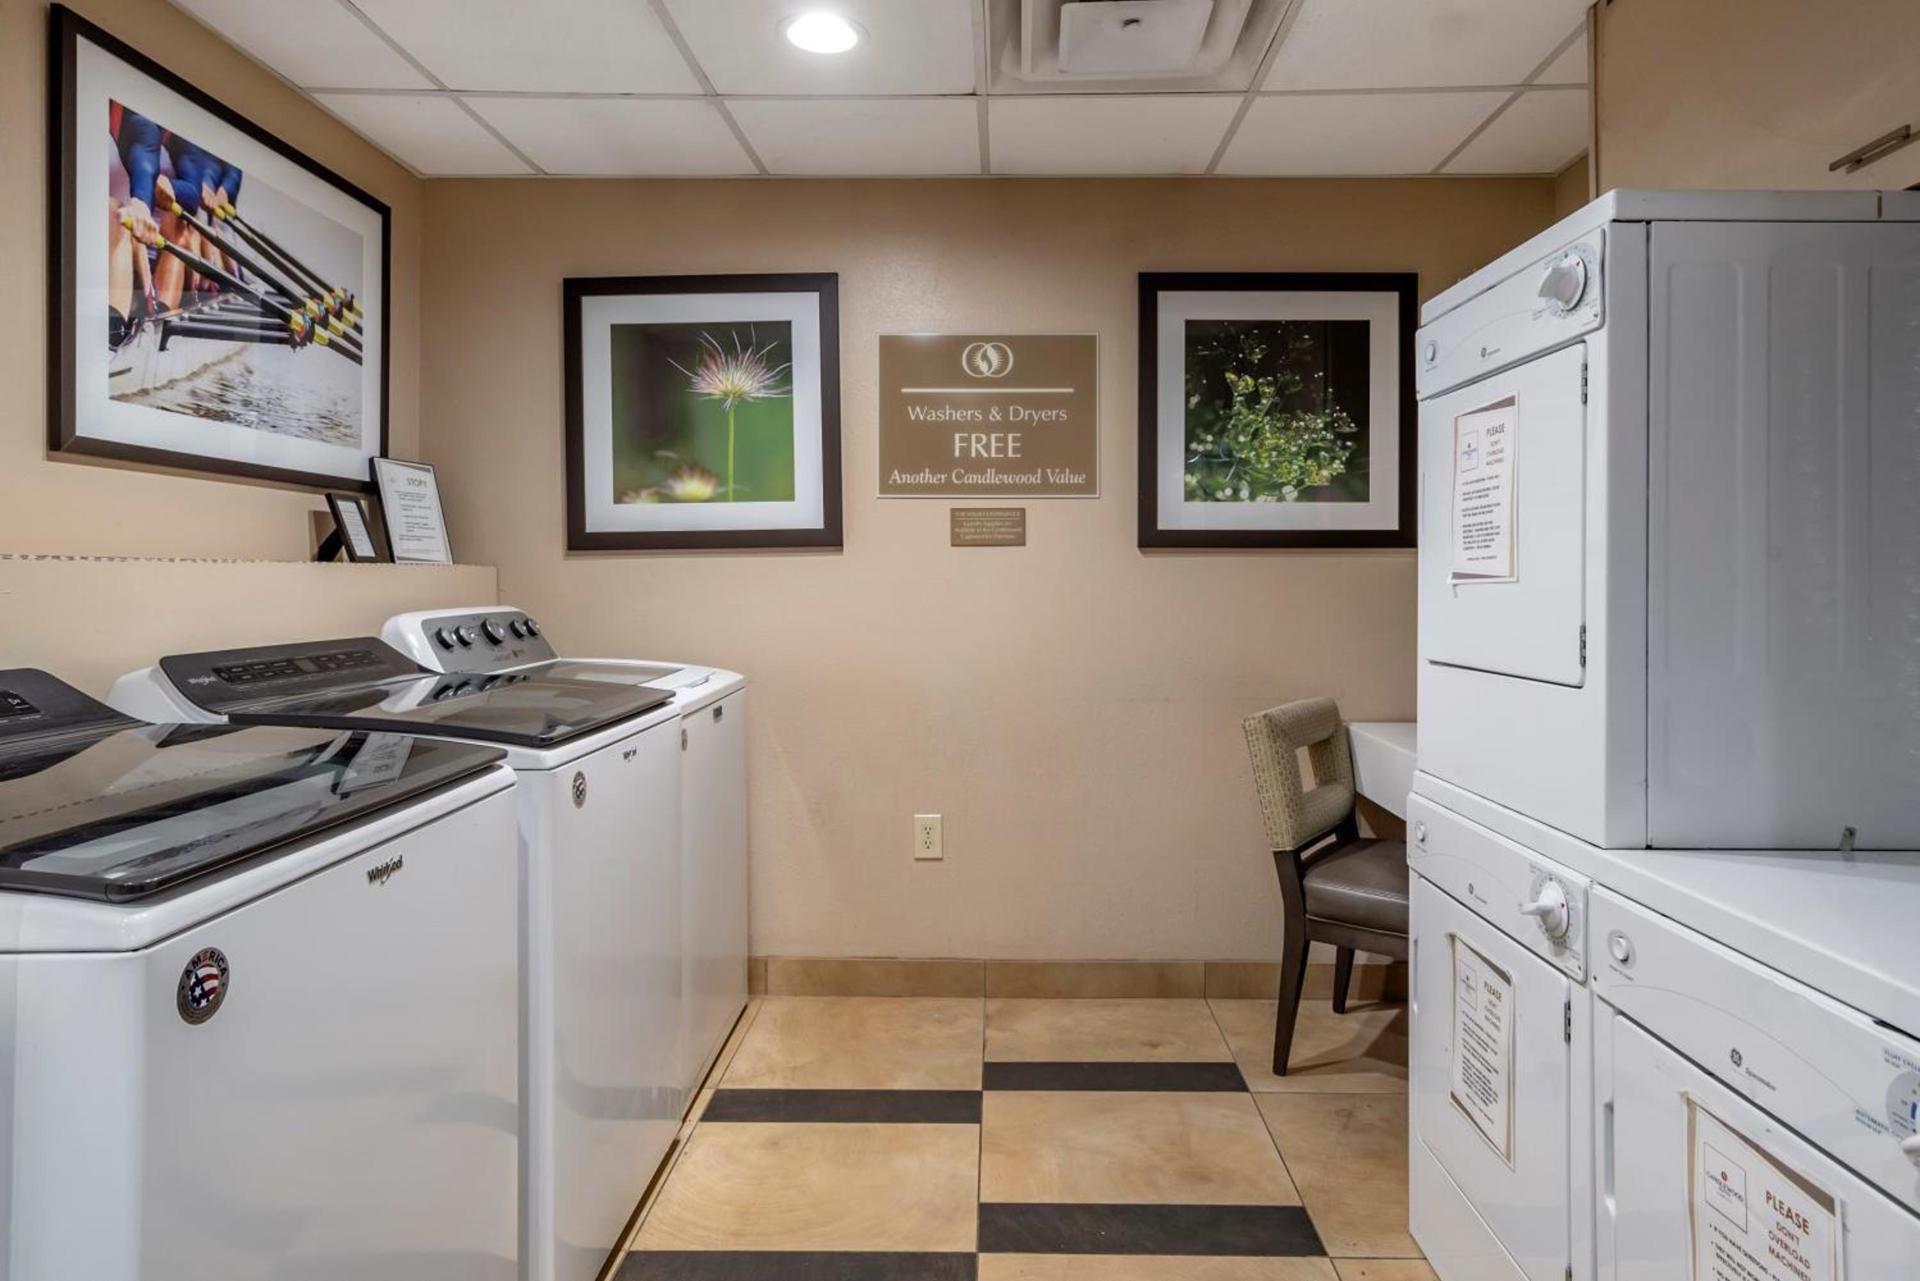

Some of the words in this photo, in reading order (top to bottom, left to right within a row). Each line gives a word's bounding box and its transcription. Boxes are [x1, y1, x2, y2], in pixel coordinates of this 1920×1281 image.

[908, 405, 982, 421] Washers
[989, 406, 1002, 421] &
[1009, 405, 1068, 427] Dryers
[954, 433, 1022, 458] FREE
[888, 468, 947, 484] Another
[952, 468, 1042, 484] Candlewood
[1046, 468, 1087, 484] Value
[184, 950, 227, 979] AMERICA
[1765, 1189, 1809, 1235] PLEASE
[1768, 1229, 1811, 1270] OVERLOAD
